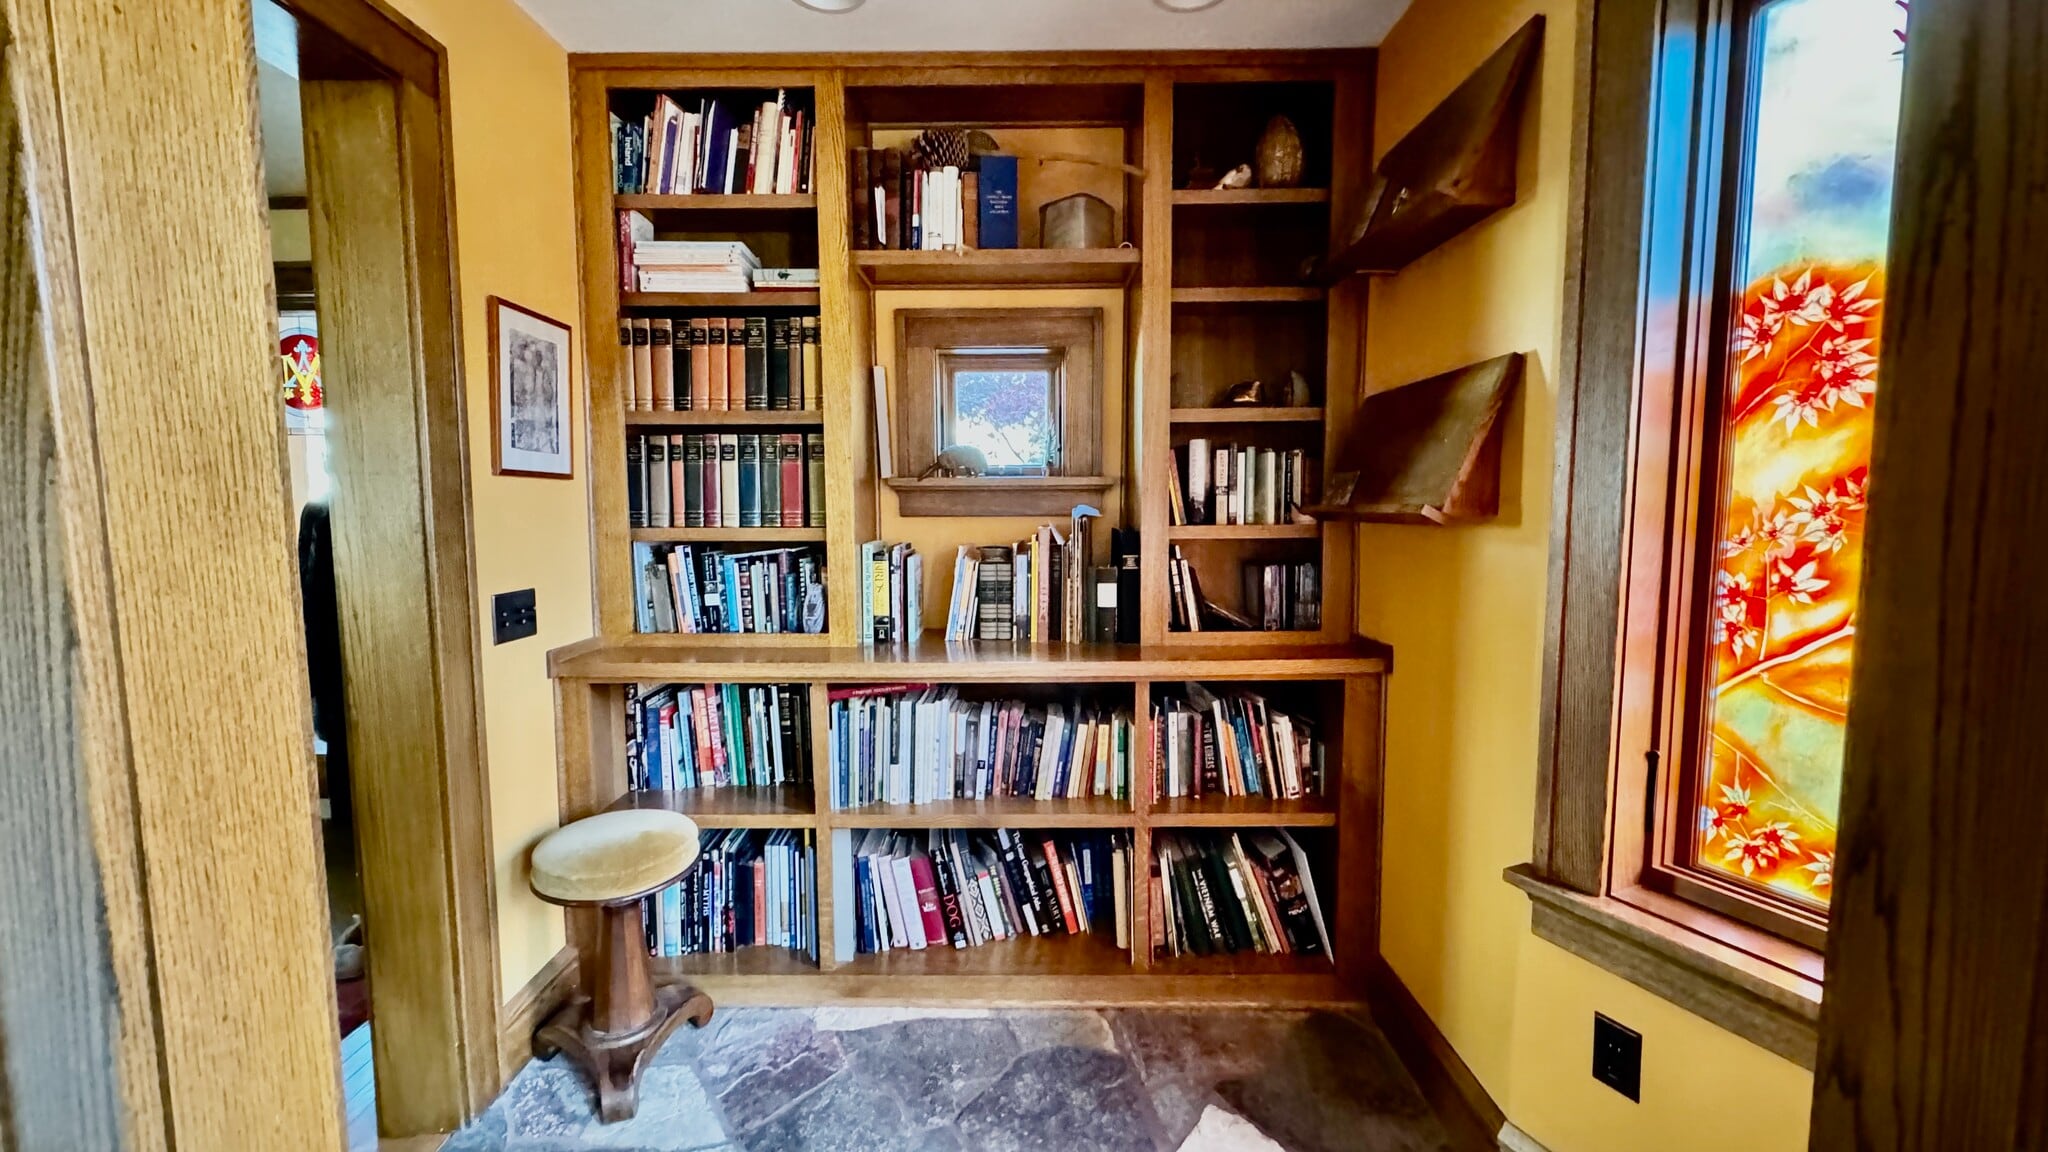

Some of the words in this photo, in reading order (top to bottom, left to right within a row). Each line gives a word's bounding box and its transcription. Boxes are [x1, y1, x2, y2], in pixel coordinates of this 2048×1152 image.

[624, 136, 632, 166] Ireland
[1204, 728, 1213, 743] TWO
[944, 894, 961, 928] DOG
[1199, 879, 1216, 918] VIETNAM
[1210, 919, 1221, 939] WAR
